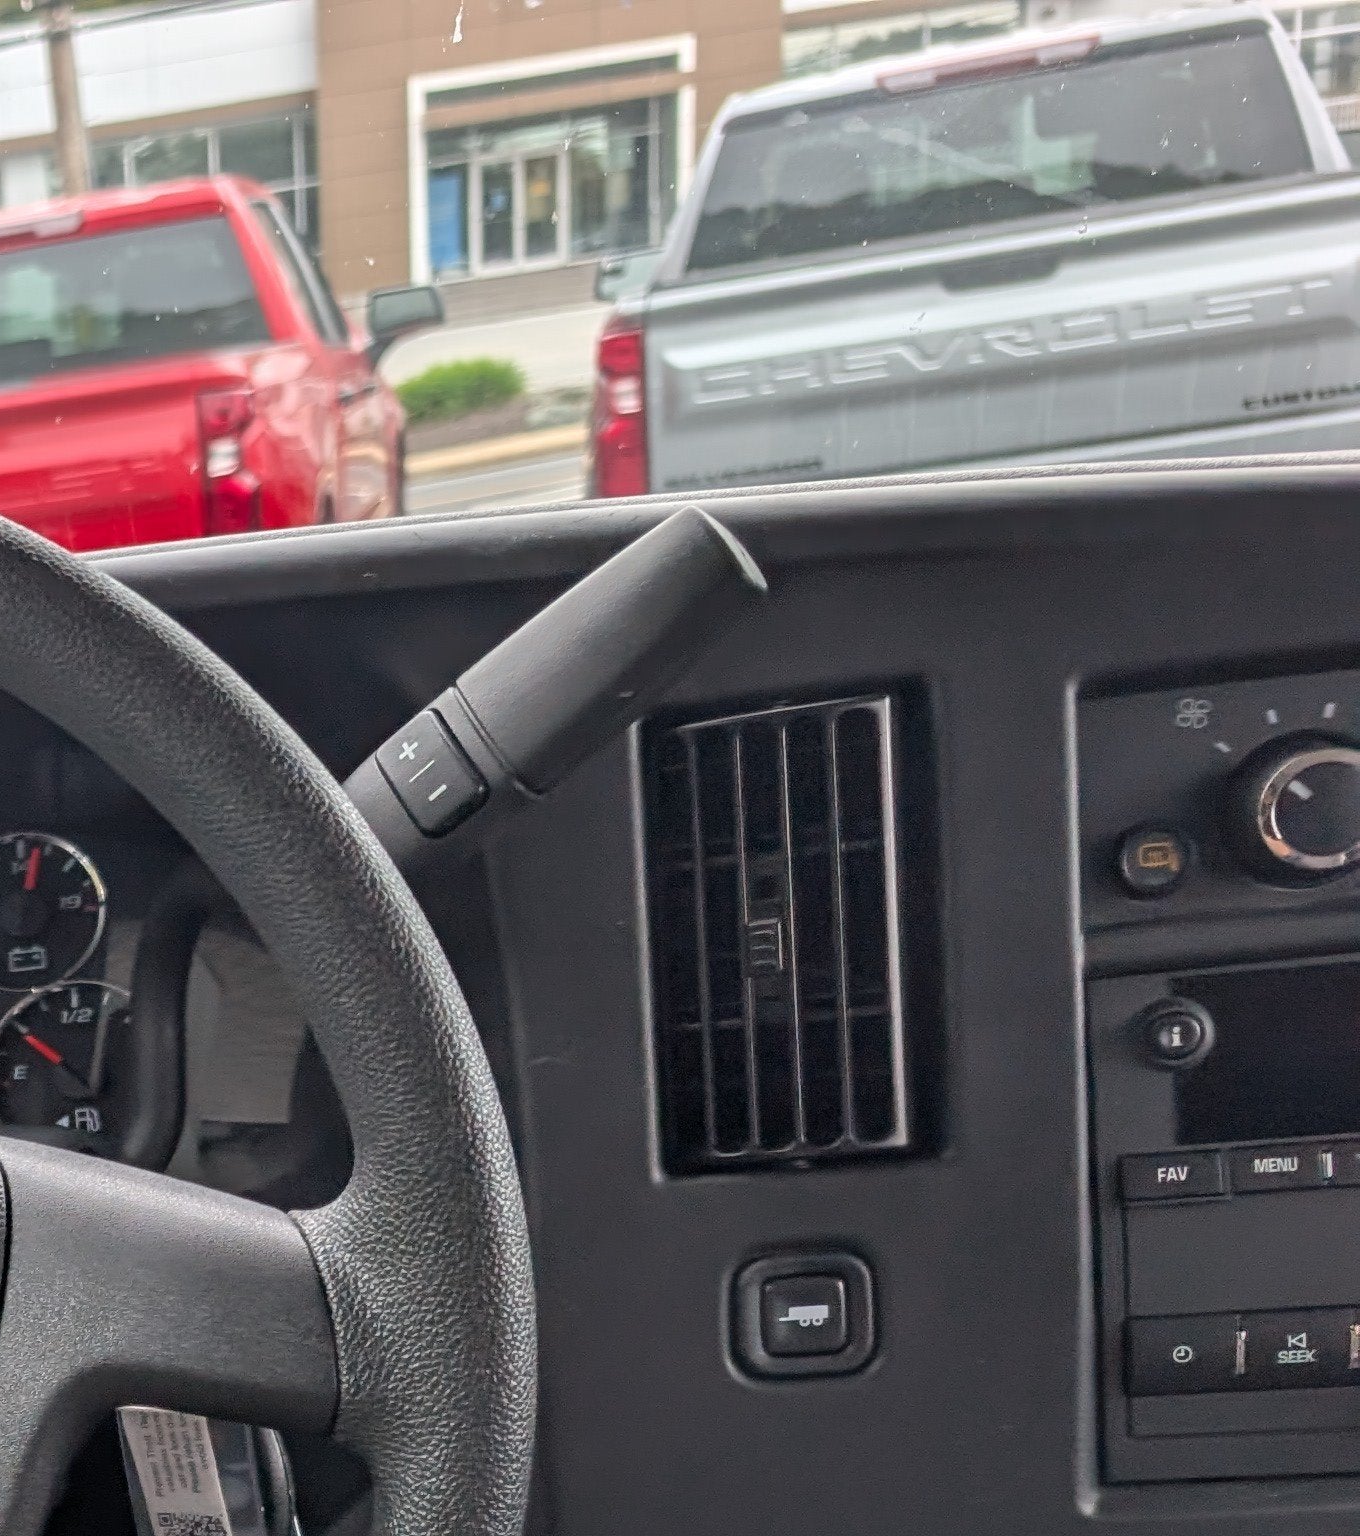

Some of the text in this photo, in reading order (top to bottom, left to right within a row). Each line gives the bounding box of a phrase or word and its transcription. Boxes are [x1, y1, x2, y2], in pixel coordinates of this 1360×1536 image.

[693, 279, 1334, 405] CHEVROLET
[60, 1006, 94, 1025] 1/2
[13, 1064, 29, 1081] E
[1157, 1165, 1189, 1183] FAV
[1253, 1156, 1299, 1174] MENU
[1276, 1347, 1319, 1364] SEEK
